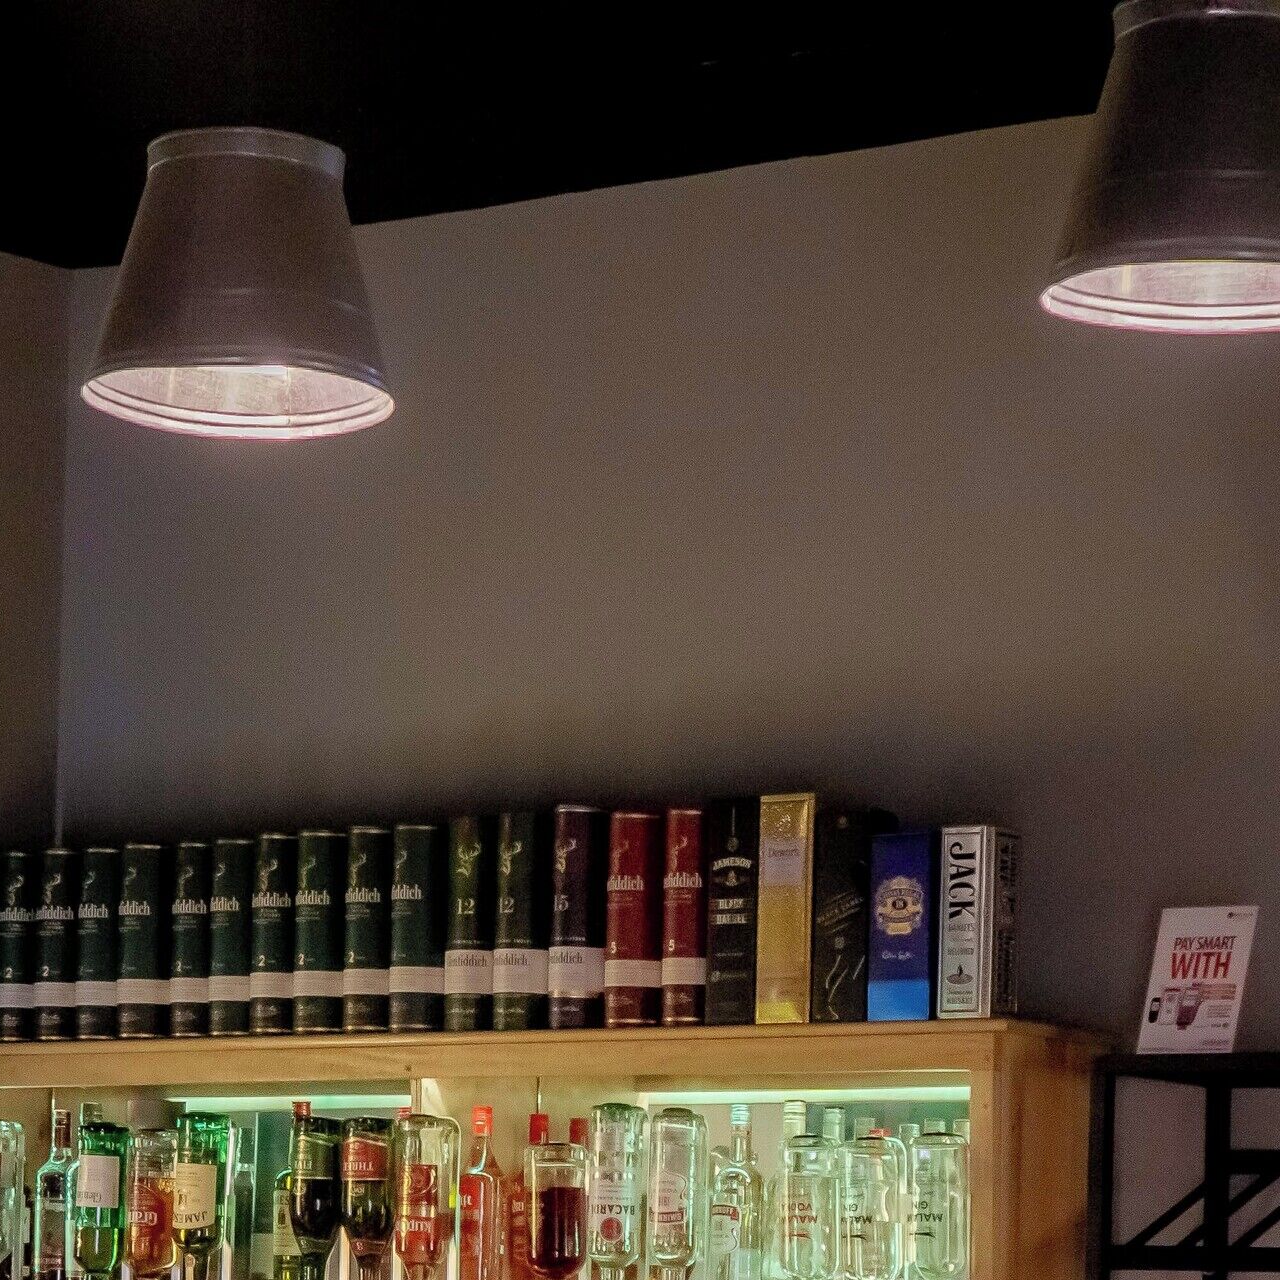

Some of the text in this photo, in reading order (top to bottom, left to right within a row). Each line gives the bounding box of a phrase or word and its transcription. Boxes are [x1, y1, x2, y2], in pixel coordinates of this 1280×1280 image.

[712, 856, 753, 871] JAMESON
[948, 841, 977, 919] JACK
[456, 897, 476, 915] 12
[498, 896, 516, 914] 12
[553, 894, 570, 912] 15
[1173, 935, 1238, 951] PAY SMART
[1171, 951, 1232, 980] WITH
[127, 1210, 158, 1226] Gran
[173, 1210, 208, 1224] JAMES
